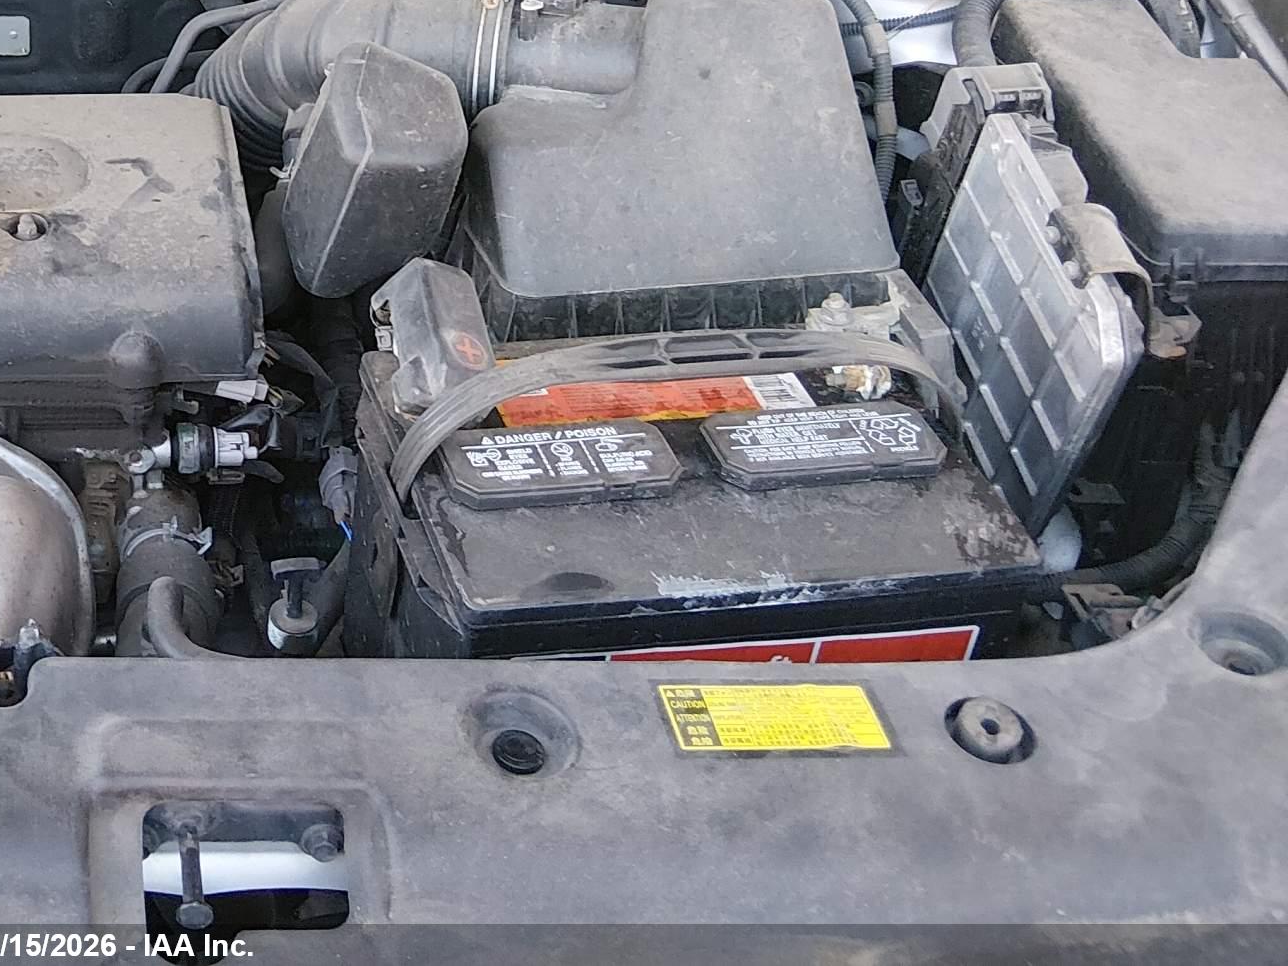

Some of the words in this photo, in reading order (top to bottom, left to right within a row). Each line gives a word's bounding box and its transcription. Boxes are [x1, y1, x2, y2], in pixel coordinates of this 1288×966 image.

[494, 432, 552, 444] DANGER
[564, 427, 617, 438] POISON
[670, 700, 706, 710] CAUTION
